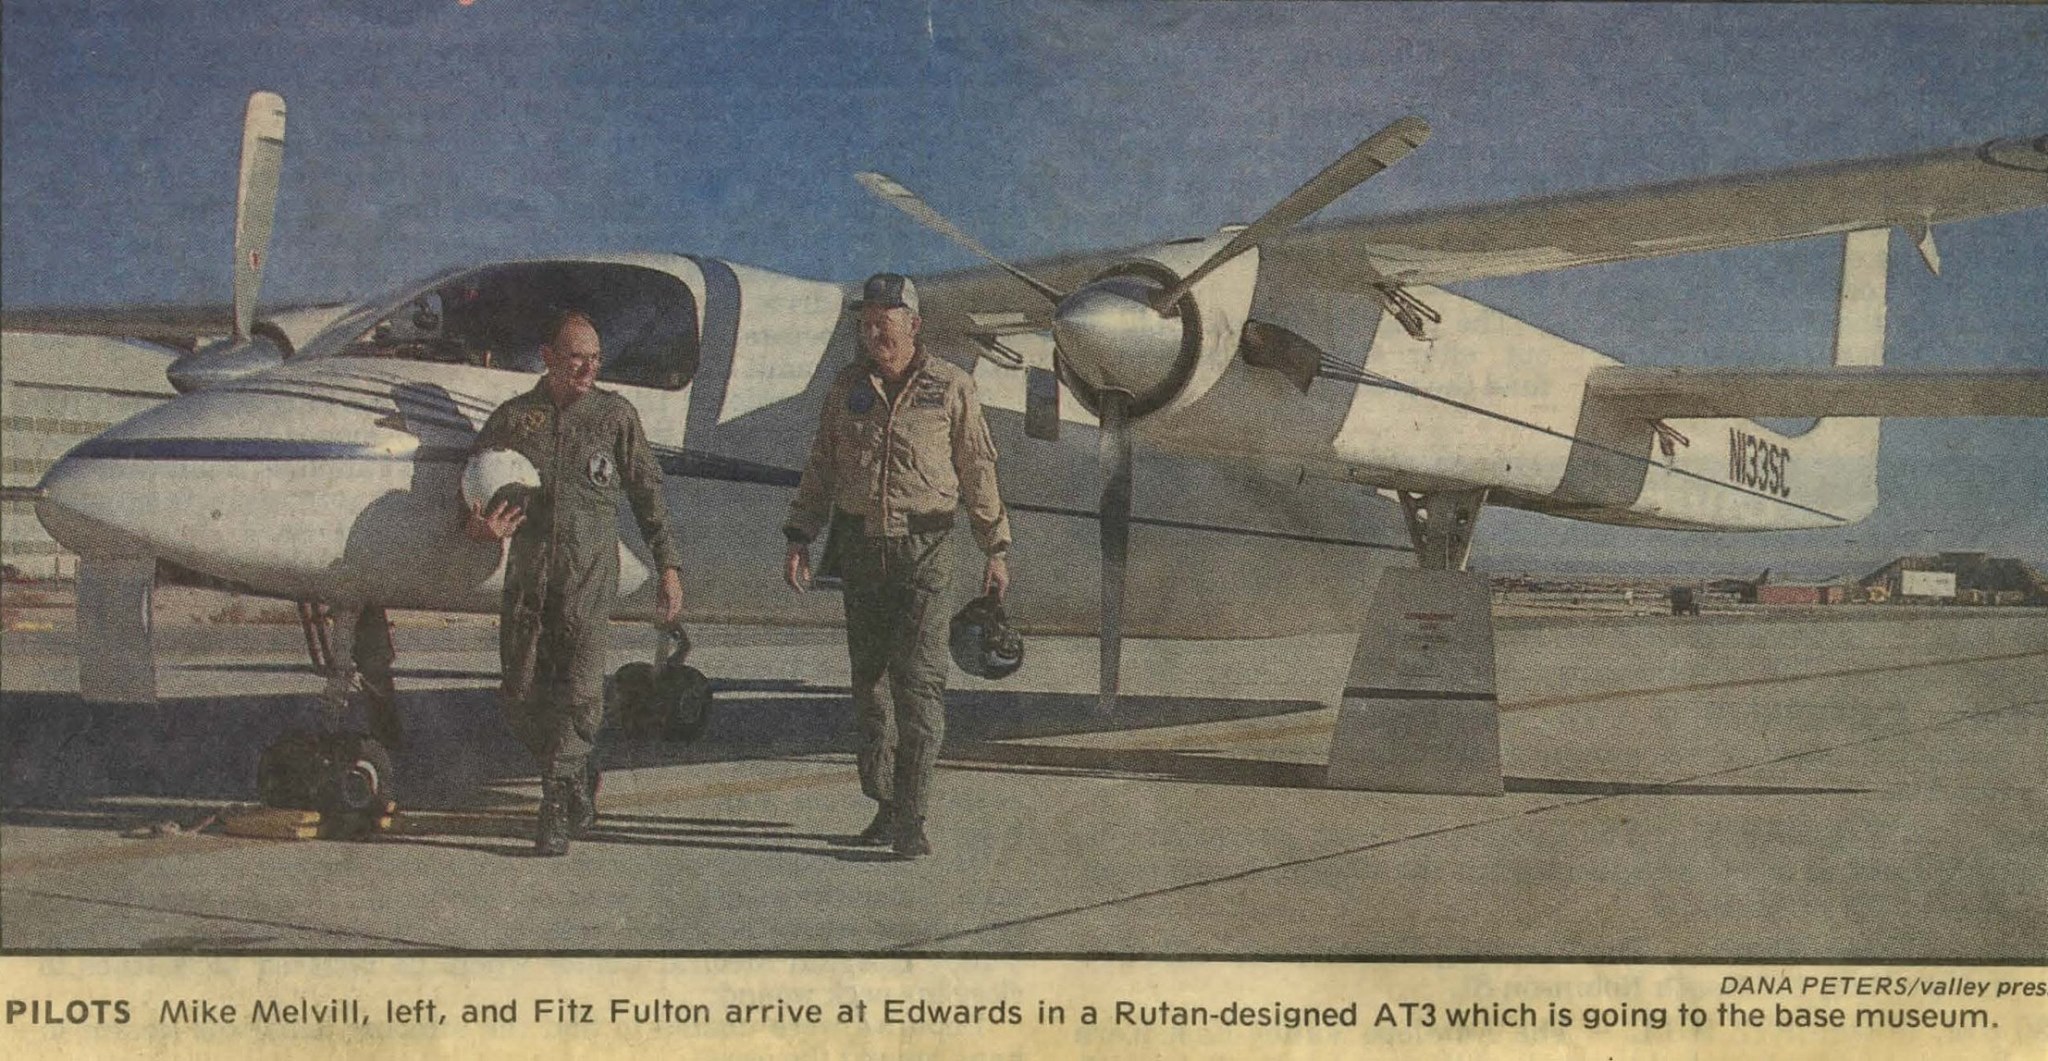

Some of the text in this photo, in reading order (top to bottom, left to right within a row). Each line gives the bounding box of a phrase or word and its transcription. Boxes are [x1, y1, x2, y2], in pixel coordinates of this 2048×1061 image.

[1729, 427, 1790, 497] N133SC
[1720, 976, 2048, 998] DANA PETERS/valley pres
[7, 998, 1998, 1030] PILOTS Mike Melvill, left, and Fitz Fulton arrive at Edwards in a Rutan-designed AT3 which is going to the base museum.
